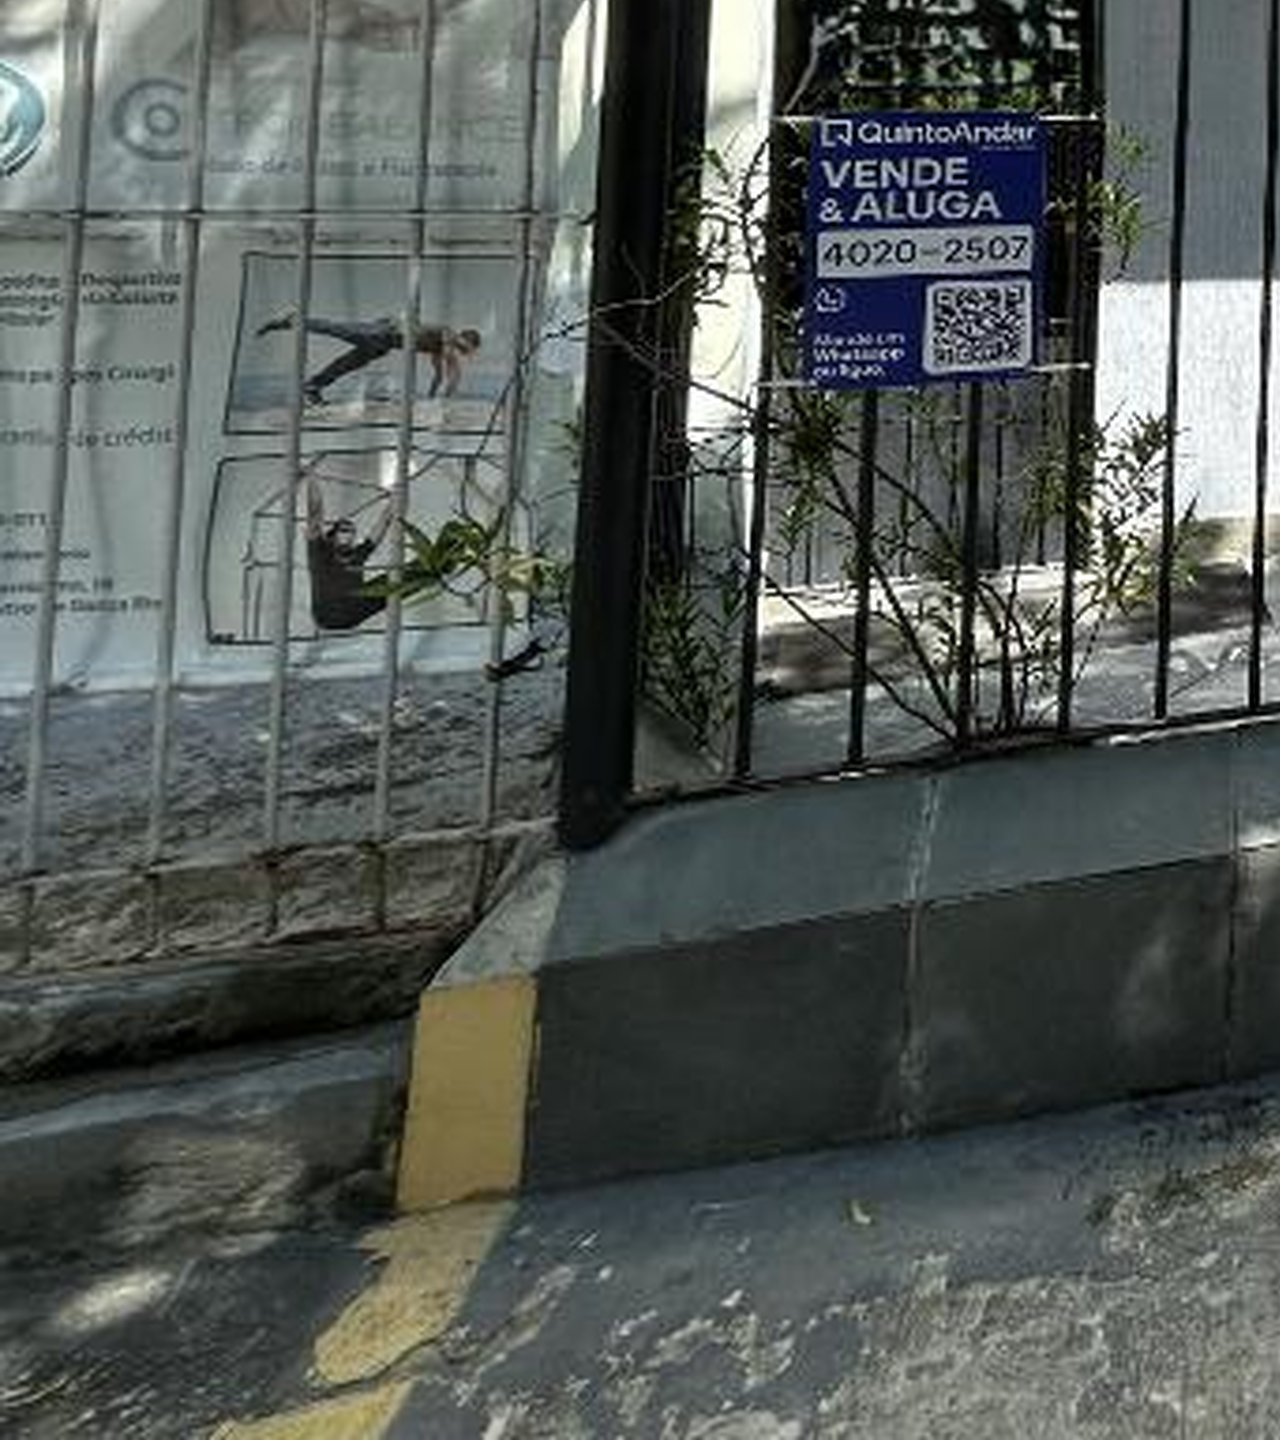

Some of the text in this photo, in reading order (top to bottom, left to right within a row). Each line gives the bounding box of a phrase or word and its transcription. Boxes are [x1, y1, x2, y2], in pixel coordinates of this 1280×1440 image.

[858, 122, 1036, 145] QuintoAndar
[822, 157, 970, 188] VENDE
[819, 191, 1003, 223] & ALUGA
[822, 236, 1029, 267] 4020-2507
